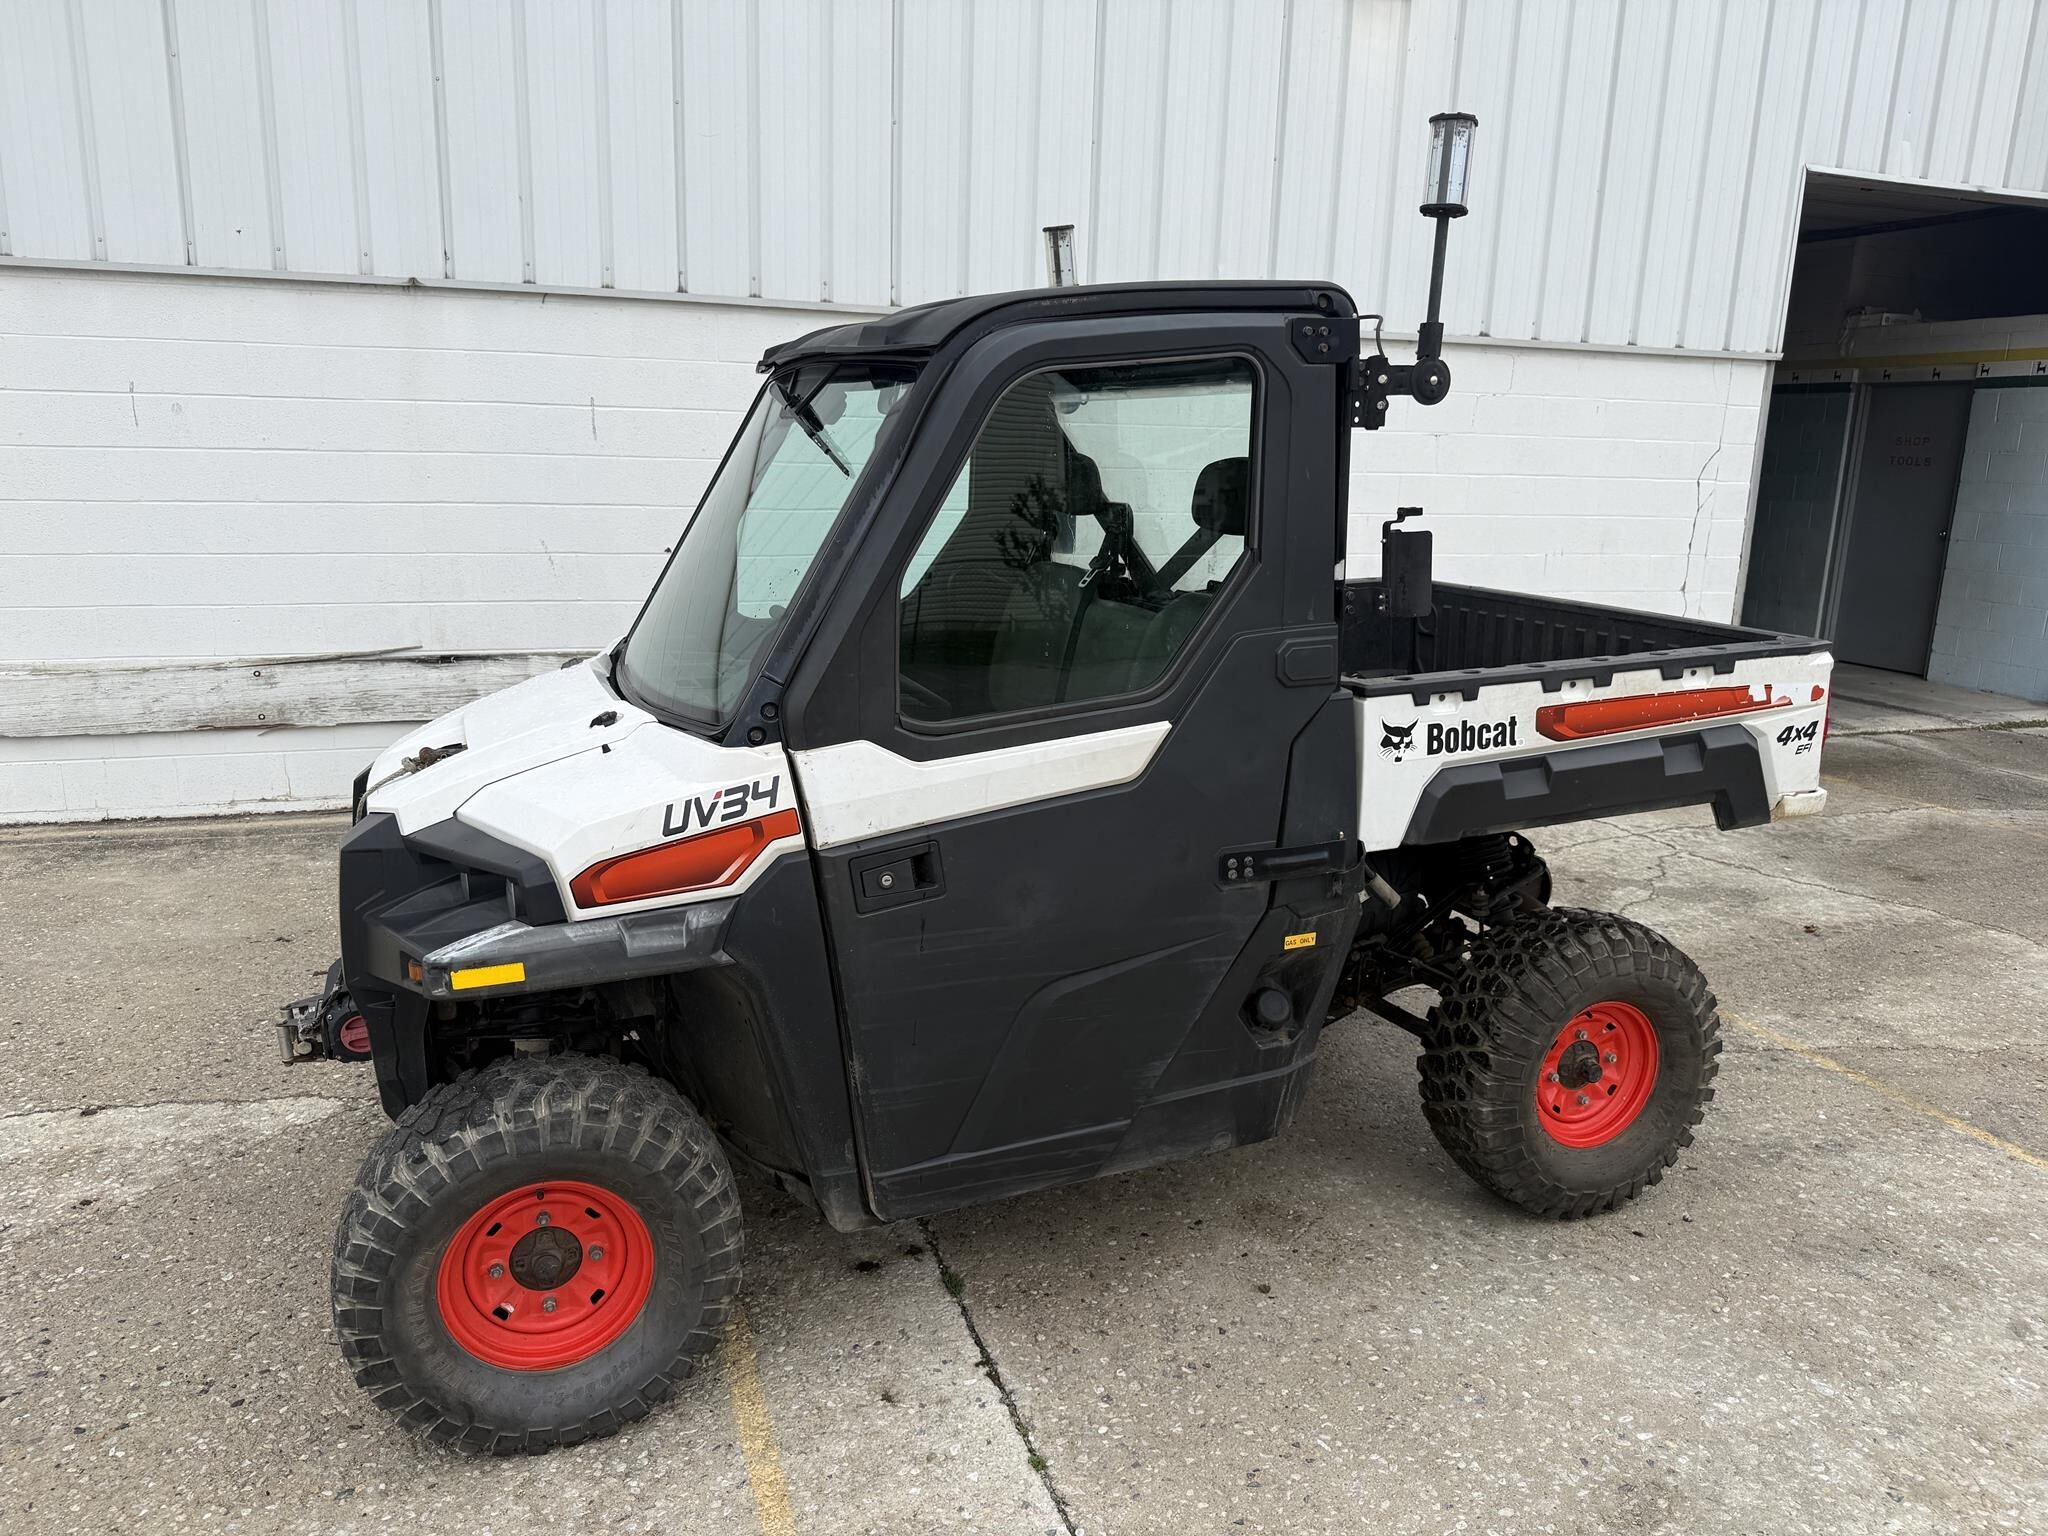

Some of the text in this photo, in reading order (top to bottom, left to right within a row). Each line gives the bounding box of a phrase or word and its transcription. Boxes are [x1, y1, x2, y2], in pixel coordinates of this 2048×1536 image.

[1895, 436, 1931, 447] SHOP
[1888, 455, 1932, 467] TOOLS
[1427, 716, 1517, 755] Bobcat
[1776, 720, 1819, 746] 4x4
[1795, 743, 1812, 755] EFI
[662, 775, 780, 837] UV34
